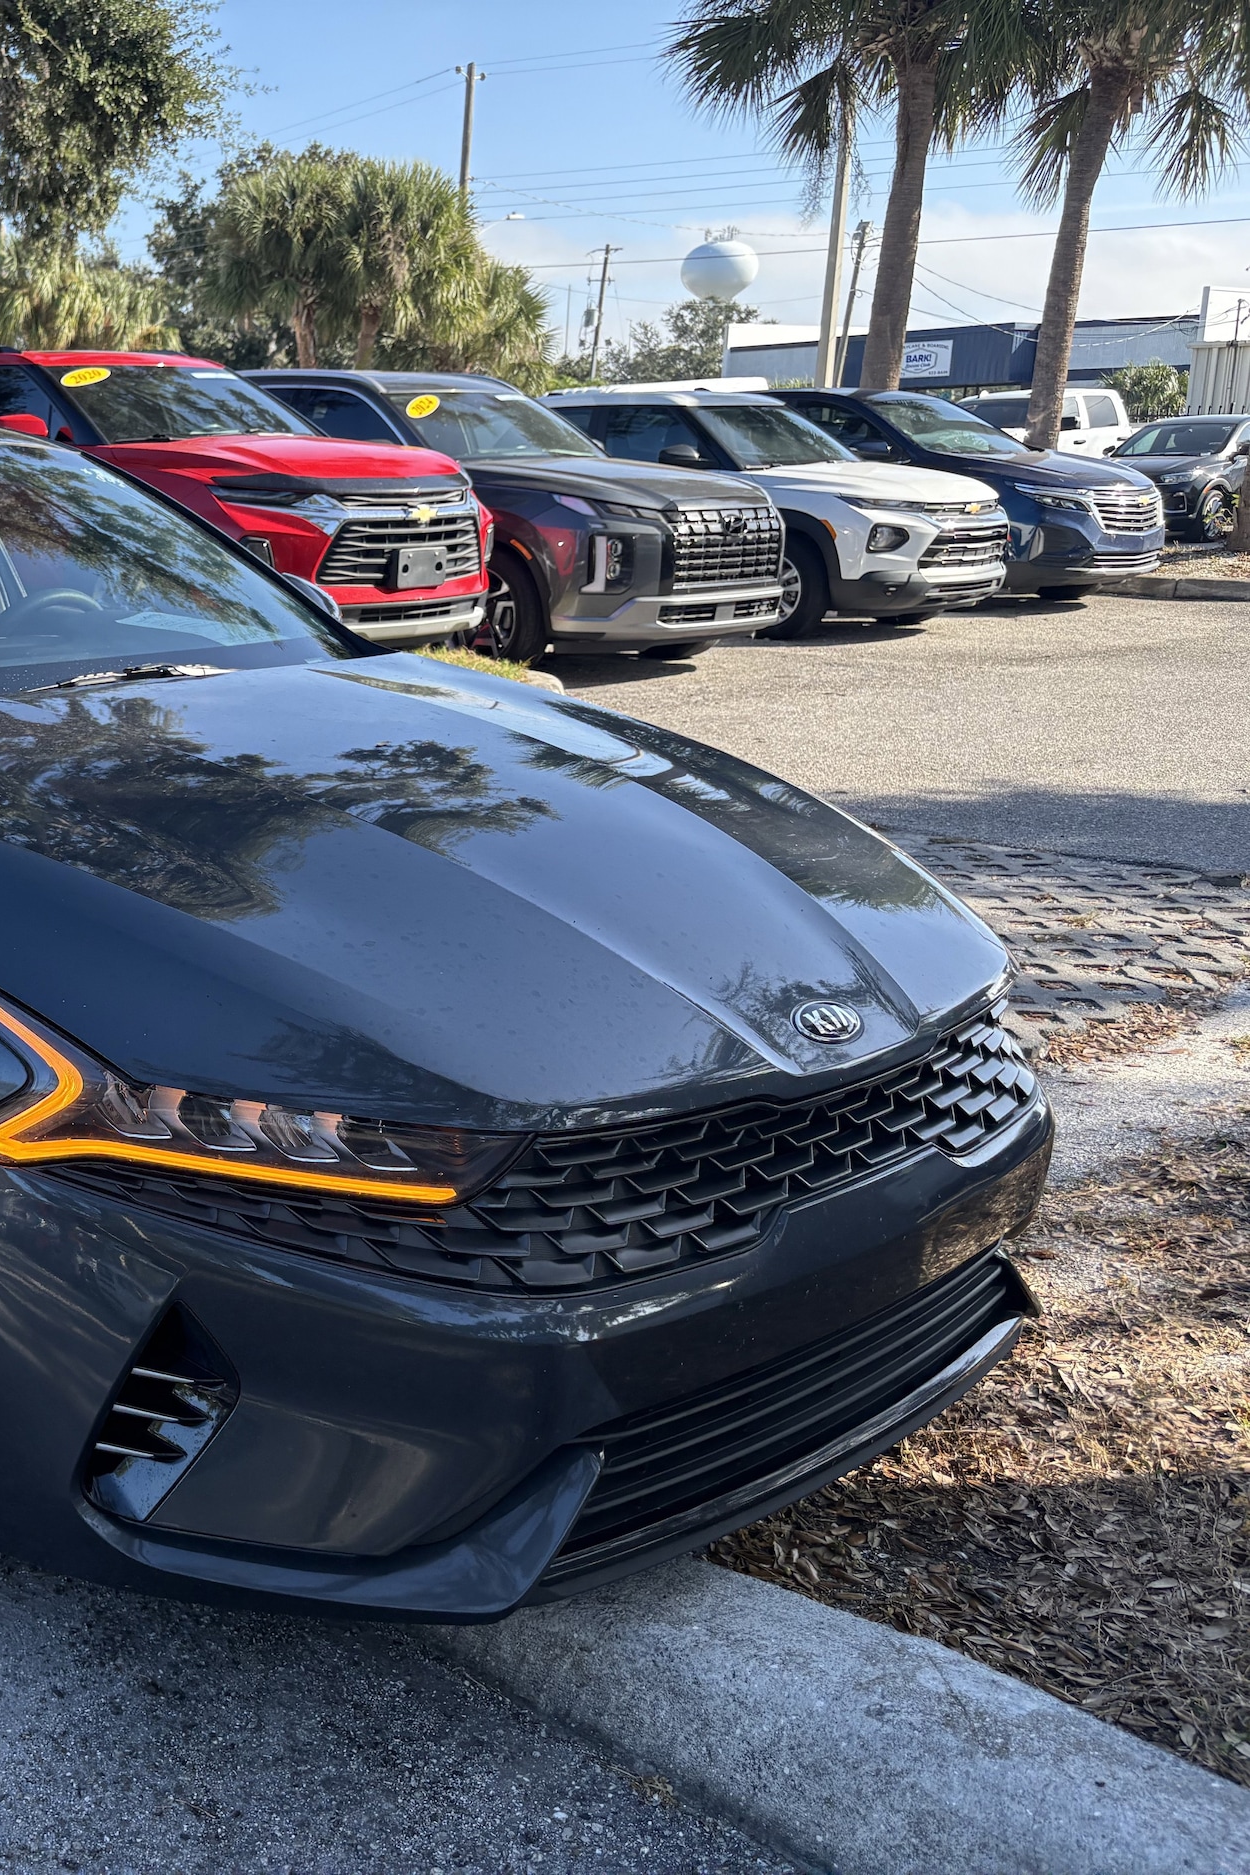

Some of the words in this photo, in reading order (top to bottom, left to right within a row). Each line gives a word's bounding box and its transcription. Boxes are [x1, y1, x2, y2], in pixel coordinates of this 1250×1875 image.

[906, 354, 932, 363] BARK!
[69, 369, 101, 384] 2020
[411, 397, 434, 415] 2024
[802, 1005, 857, 1034] KIA
